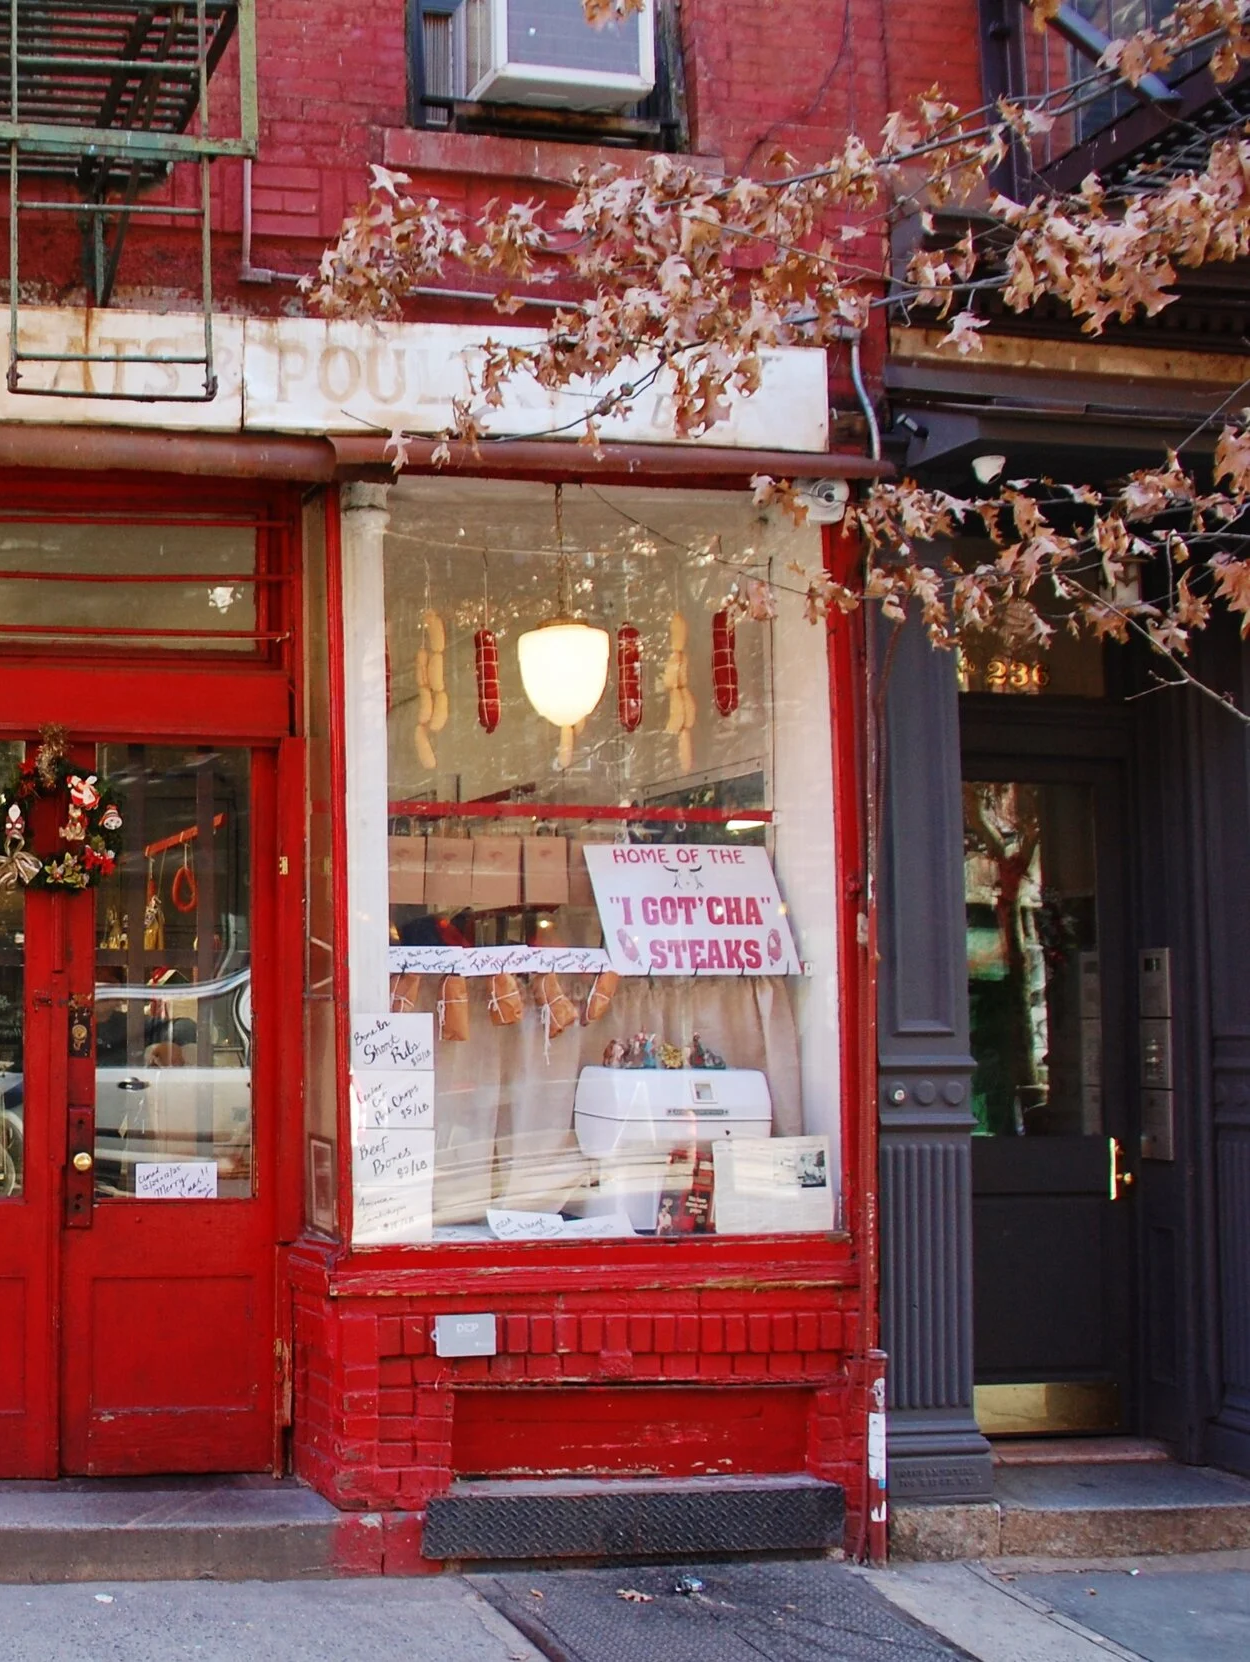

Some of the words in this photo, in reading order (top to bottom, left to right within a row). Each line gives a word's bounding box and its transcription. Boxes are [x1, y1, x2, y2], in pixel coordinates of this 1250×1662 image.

[985, 660, 1050, 688] 236
[613, 848, 669, 865] HOME
[676, 848, 699, 865] OF
[707, 849, 746, 865] THE
[649, 939, 763, 970] STEAKS
[363, 1034, 401, 1065] Short
[390, 1040, 421, 1065] Ribs
[359, 1135, 390, 1160] Beef
[373, 1147, 412, 1177] Bones
[154, 1172, 190, 1196] Merry
